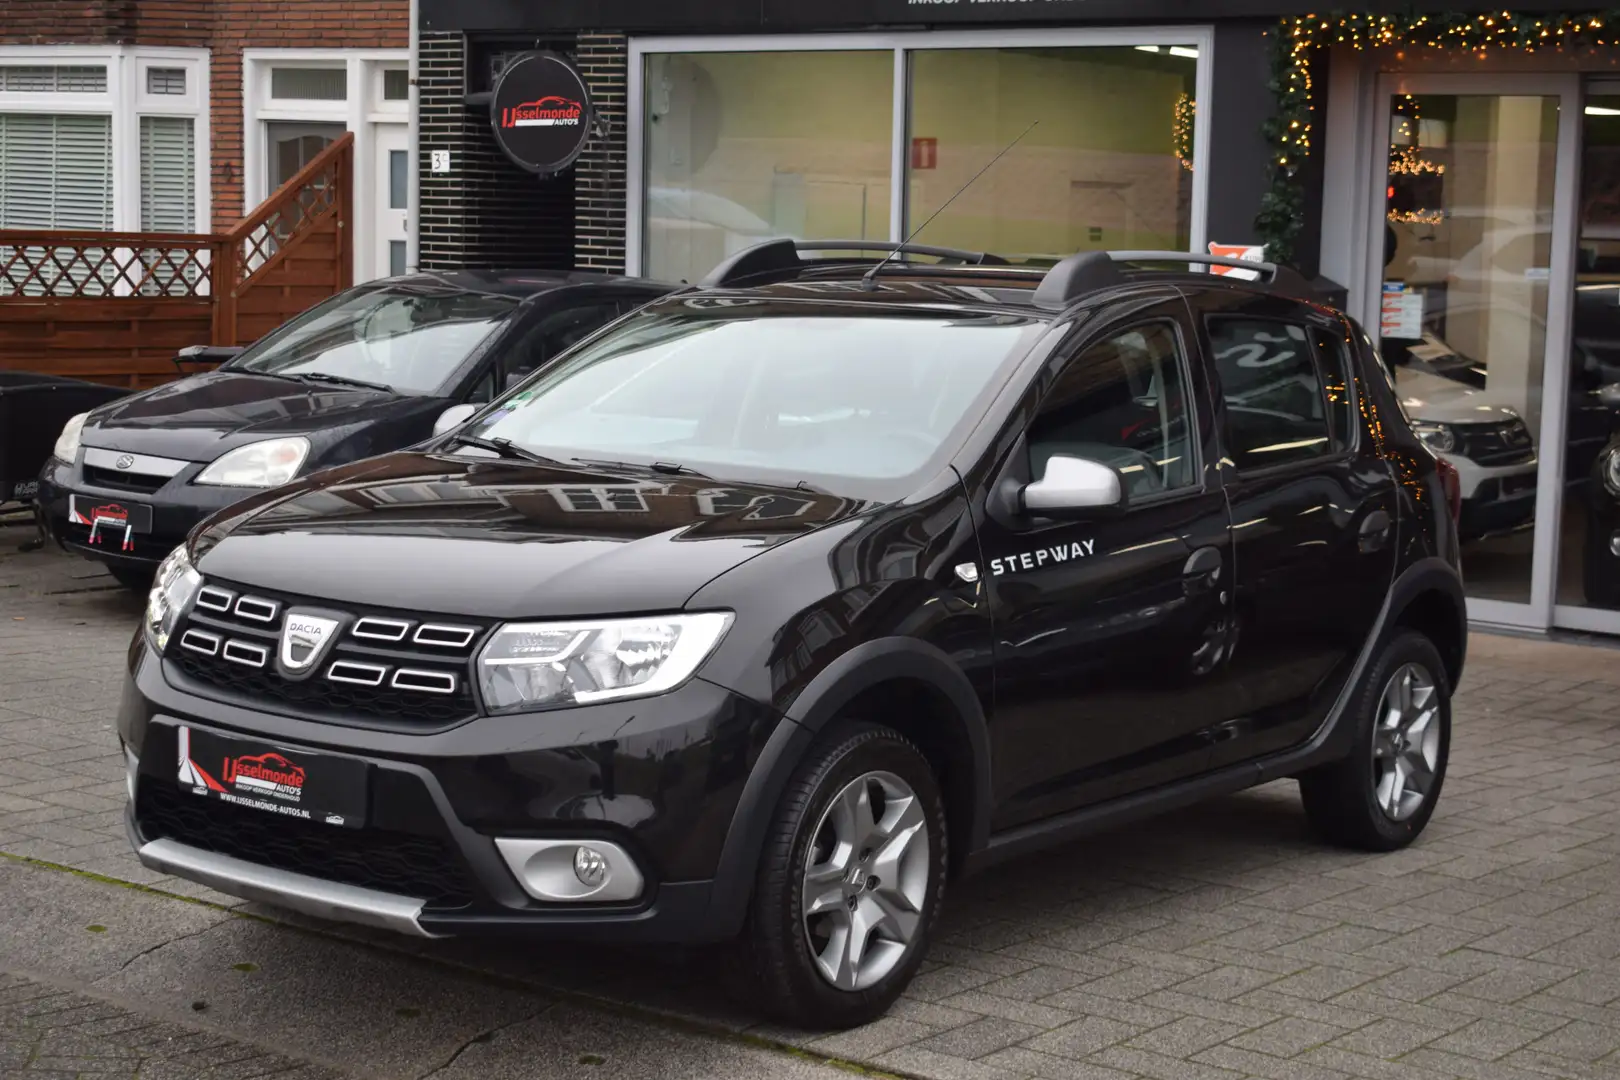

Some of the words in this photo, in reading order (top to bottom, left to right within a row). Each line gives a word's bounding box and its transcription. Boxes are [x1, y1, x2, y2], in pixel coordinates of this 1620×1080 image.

[501, 105, 581, 128] IJsselmonde
[553, 118, 579, 126] AUTO'S
[990, 538, 1095, 576] STEPWAY
[290, 622, 322, 635] DACIA
[223, 757, 304, 787] IJsselmonde
[276, 784, 302, 795] AUTO'S
[220, 793, 311, 818] WWW.IJSSELMONDE-AUTOS.NL
